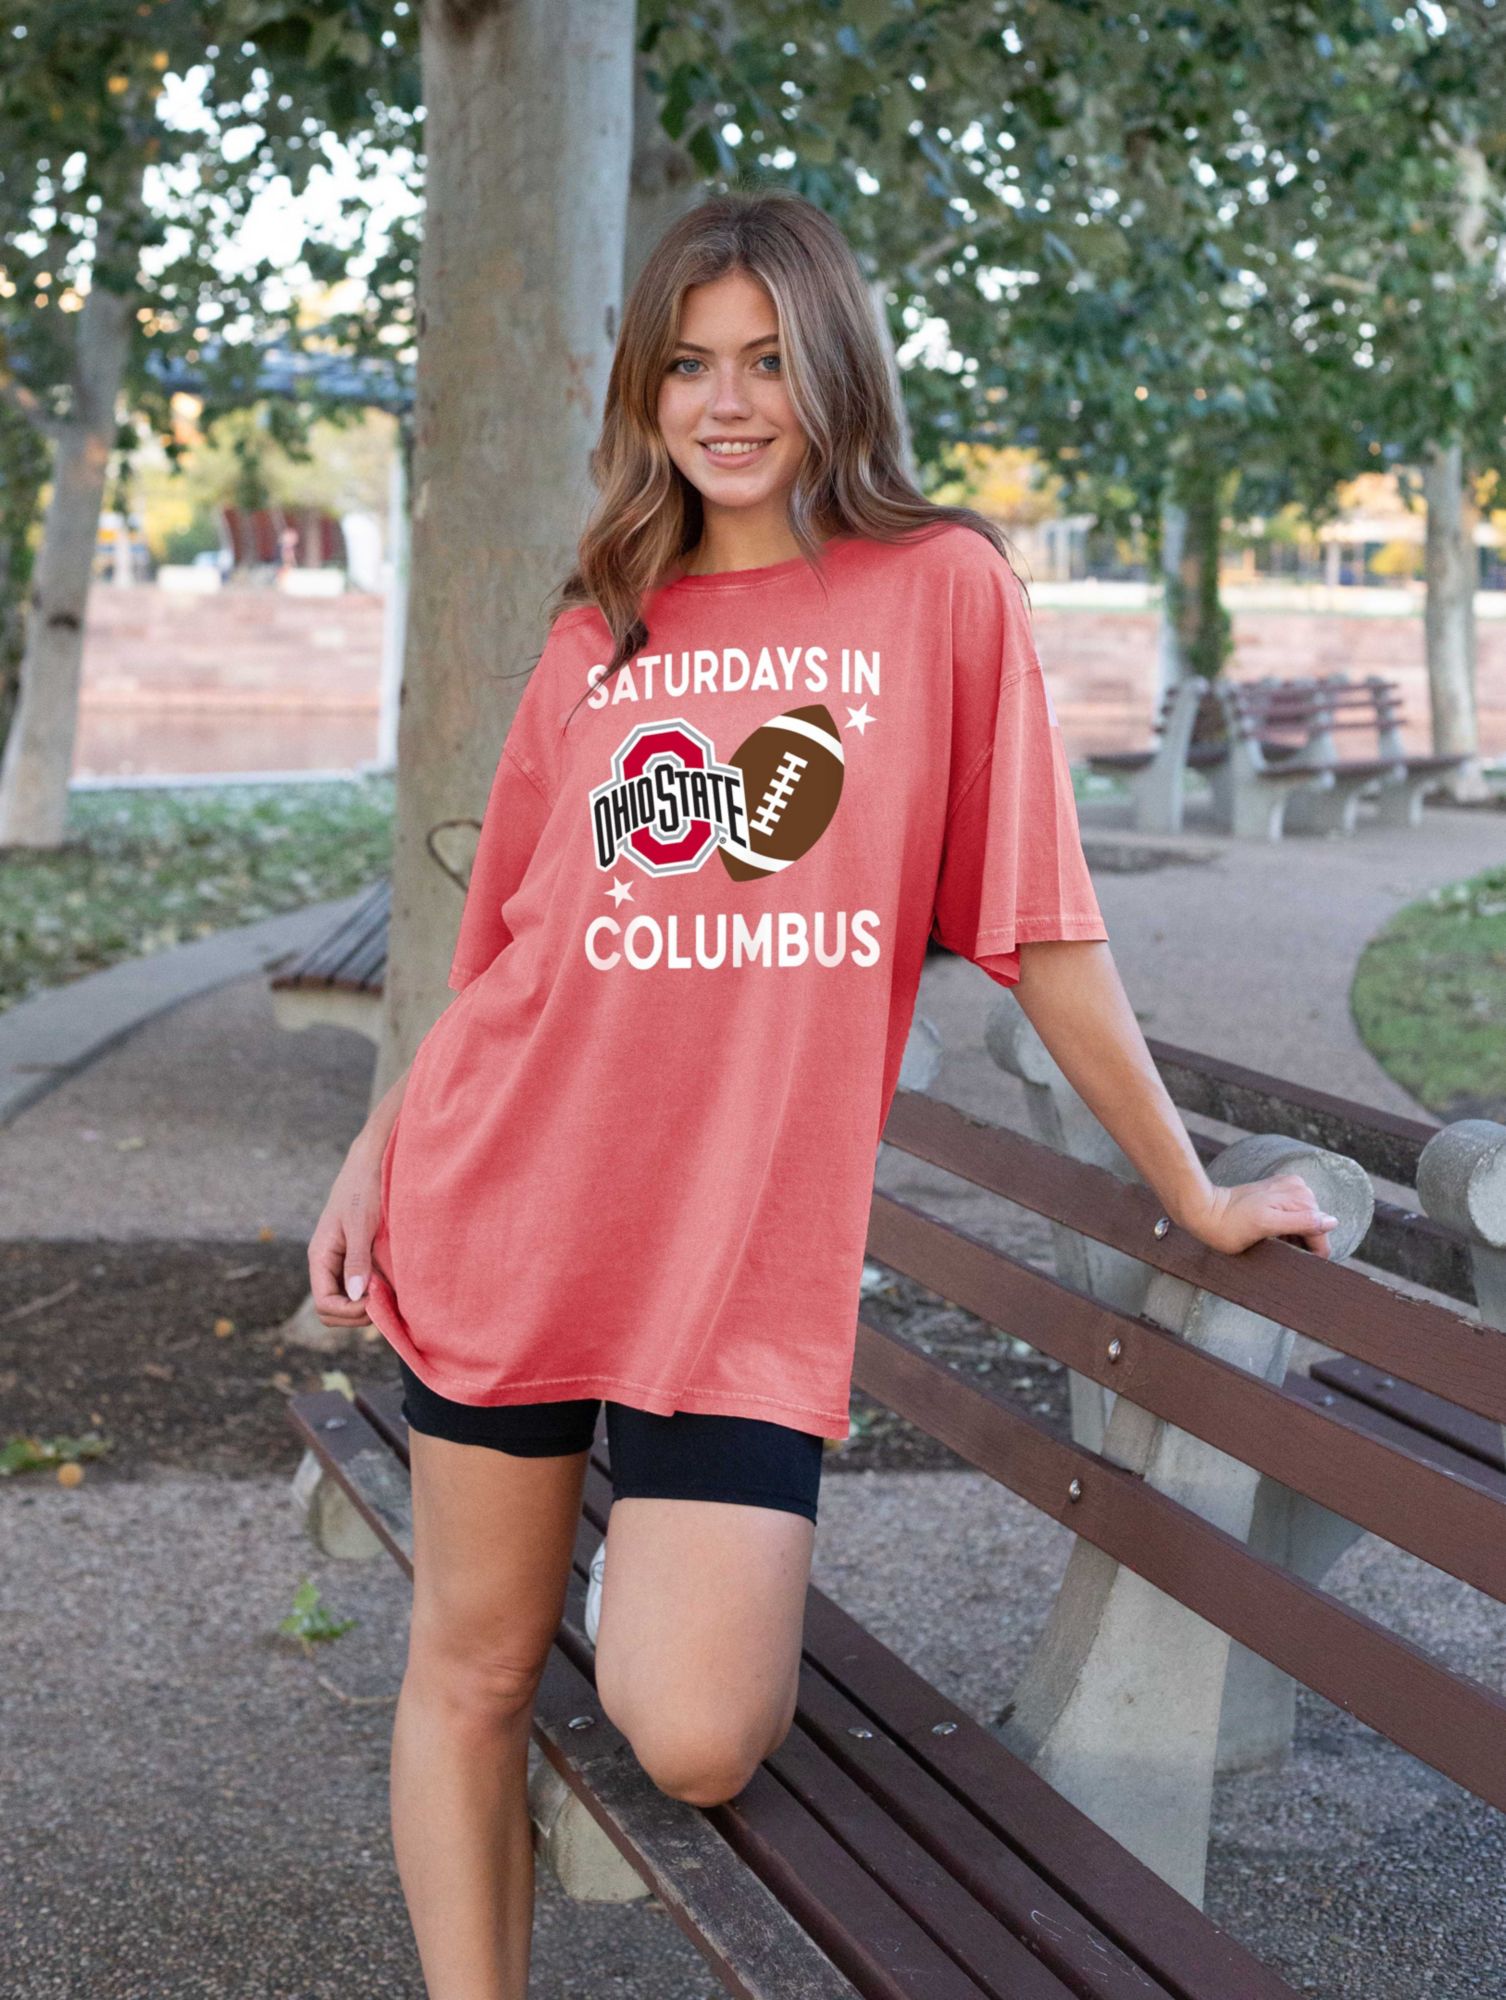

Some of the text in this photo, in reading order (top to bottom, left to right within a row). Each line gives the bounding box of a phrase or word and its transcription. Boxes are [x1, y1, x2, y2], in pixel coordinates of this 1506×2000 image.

[586, 646, 881, 709] SATURDAYS IN
[584, 909, 881, 971] COLUMBUS
